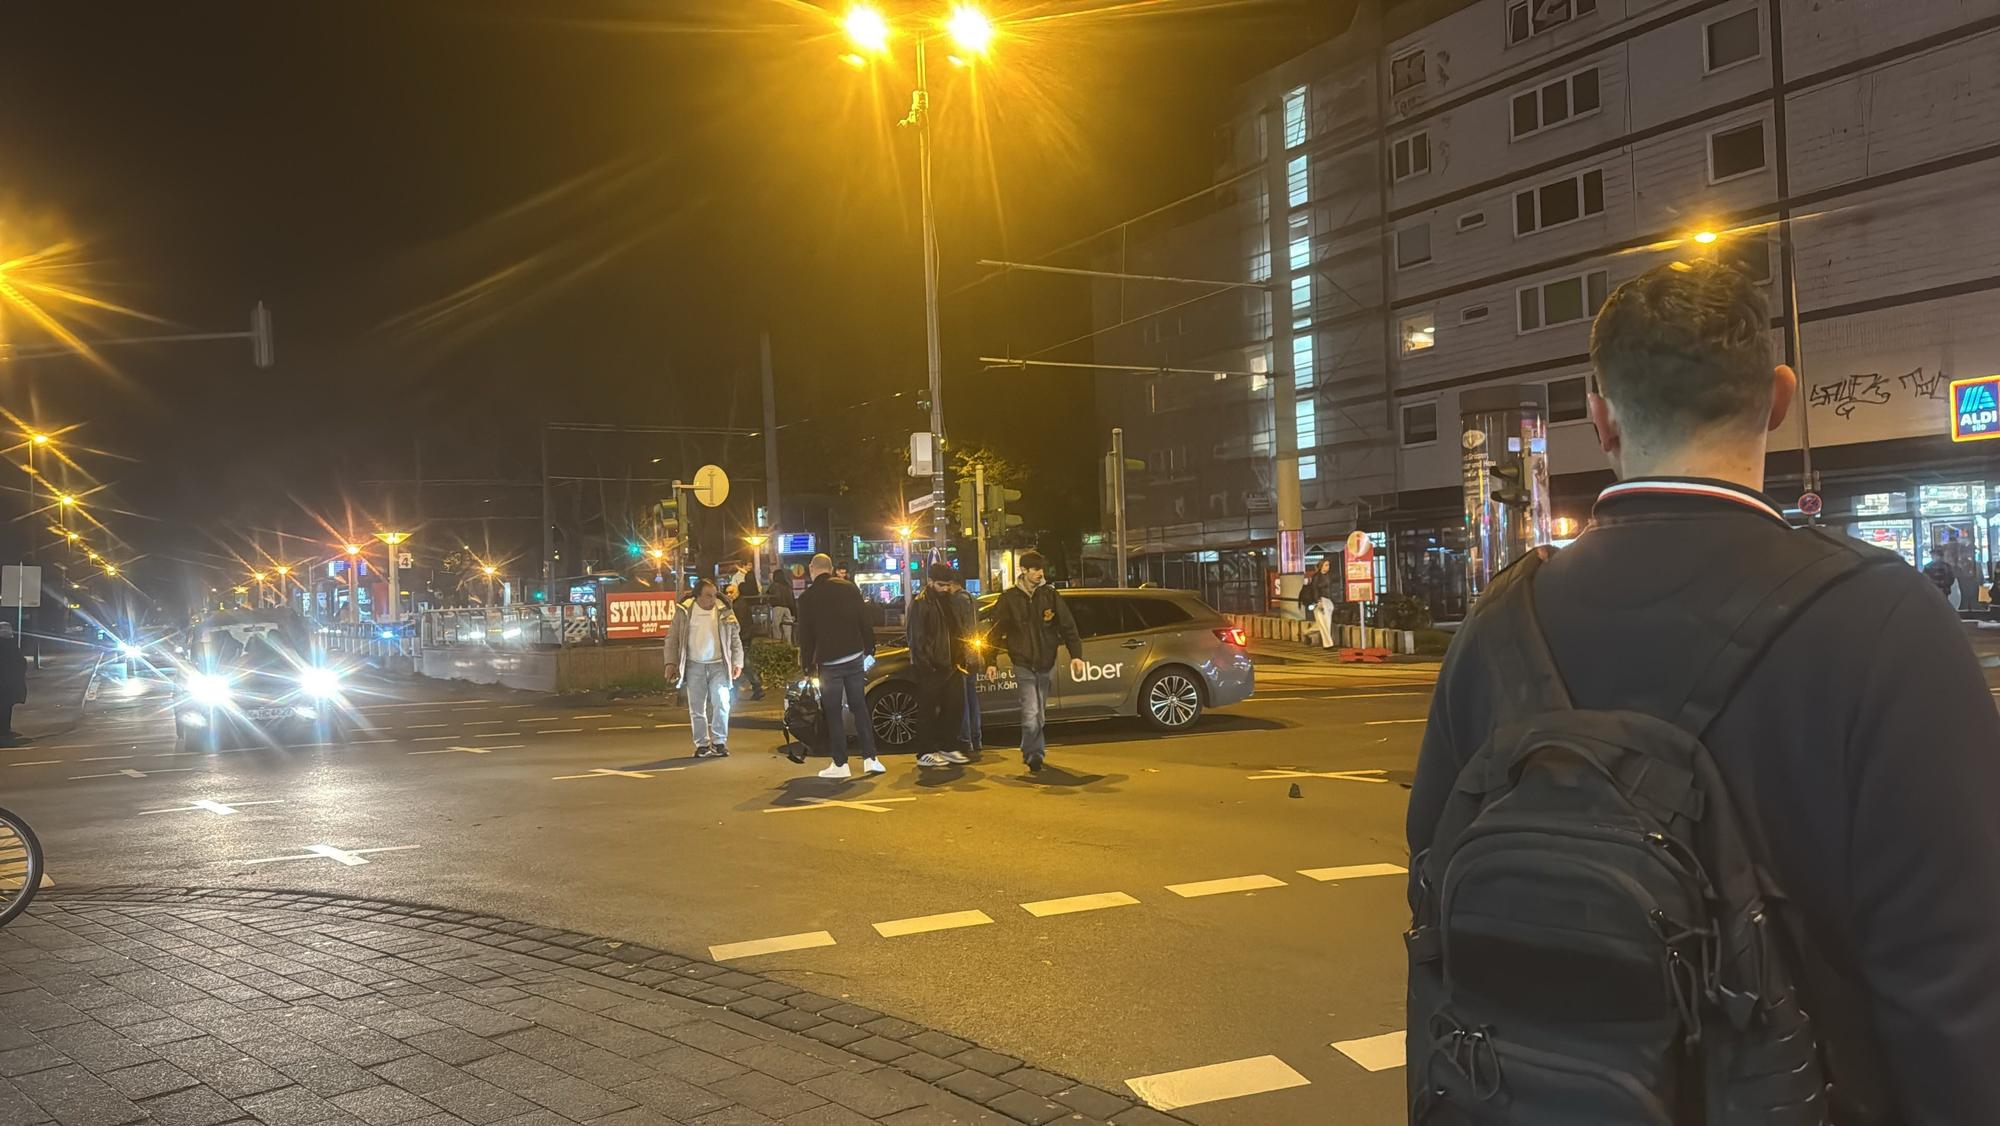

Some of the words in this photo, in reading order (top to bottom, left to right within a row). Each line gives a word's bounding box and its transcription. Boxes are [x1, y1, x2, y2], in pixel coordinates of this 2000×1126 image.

[1960, 410, 1997, 426] ALDI
[401, 557, 409, 567] 4
[1070, 660, 1123, 683] Uber
[988, 682, 996, 692] in
[998, 680, 1018, 691] Köln
